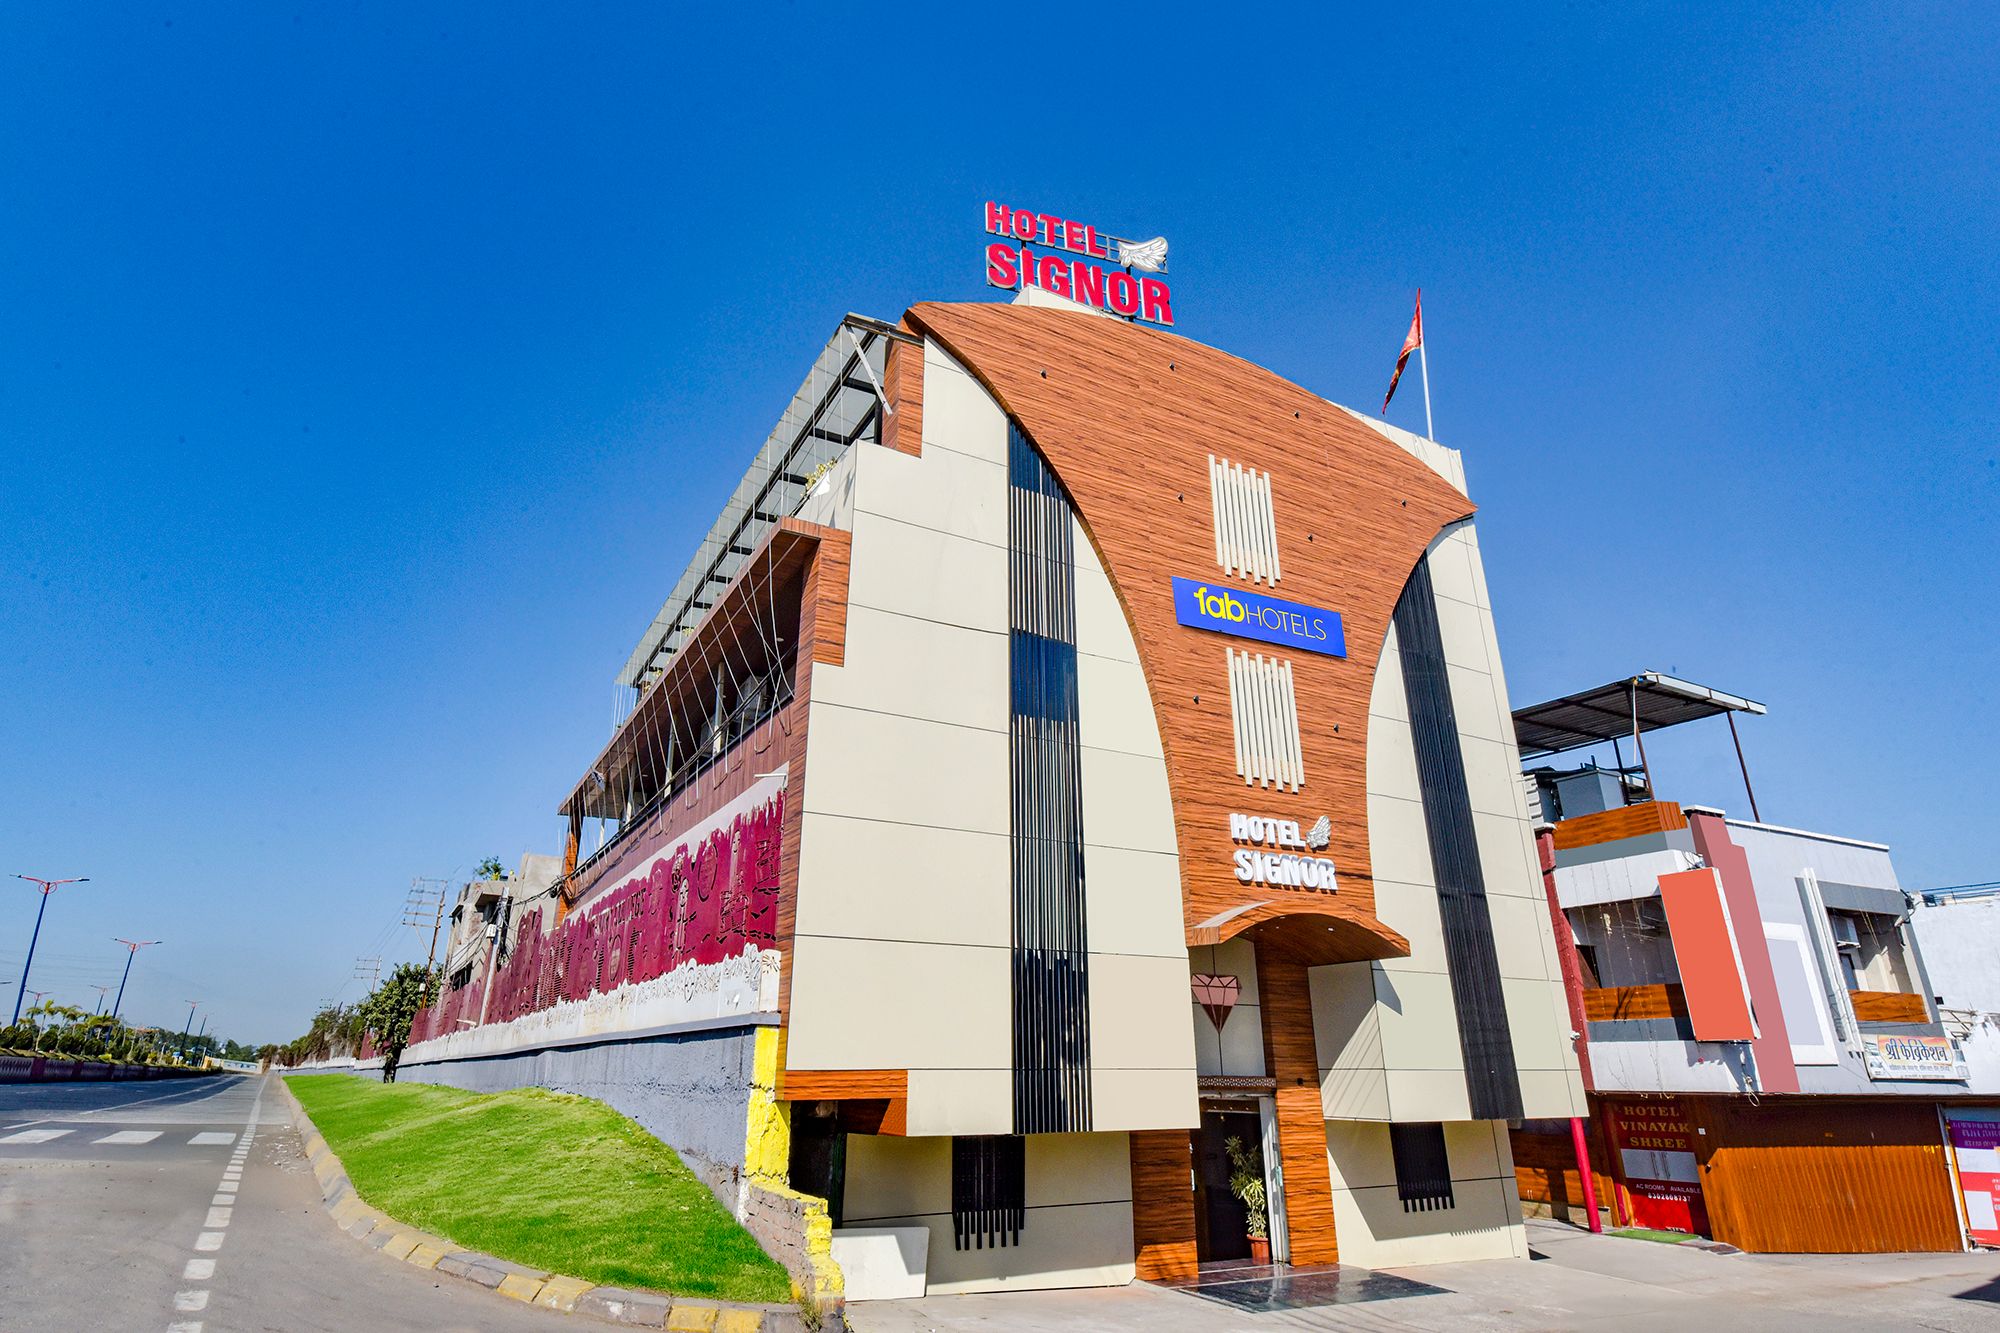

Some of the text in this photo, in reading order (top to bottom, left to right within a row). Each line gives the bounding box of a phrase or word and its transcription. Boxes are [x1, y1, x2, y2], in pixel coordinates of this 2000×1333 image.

[986, 200, 1107, 259] HOTEL
[986, 243, 1174, 326] SIGNOR
[1194, 587, 1327, 641] fabHOTELS
[1229, 813, 1306, 849] HOTEL
[1233, 849, 1338, 892] SIGNOR
[1885, 1038, 1900, 1060] श्री
[1623, 1105, 1679, 1117] HOTEL
[1620, 1121, 1690, 1133] VINAYAK
[1629, 1137, 1687, 1149] SHREE
[1670, 1186, 1701, 1194] AVAILABLE
